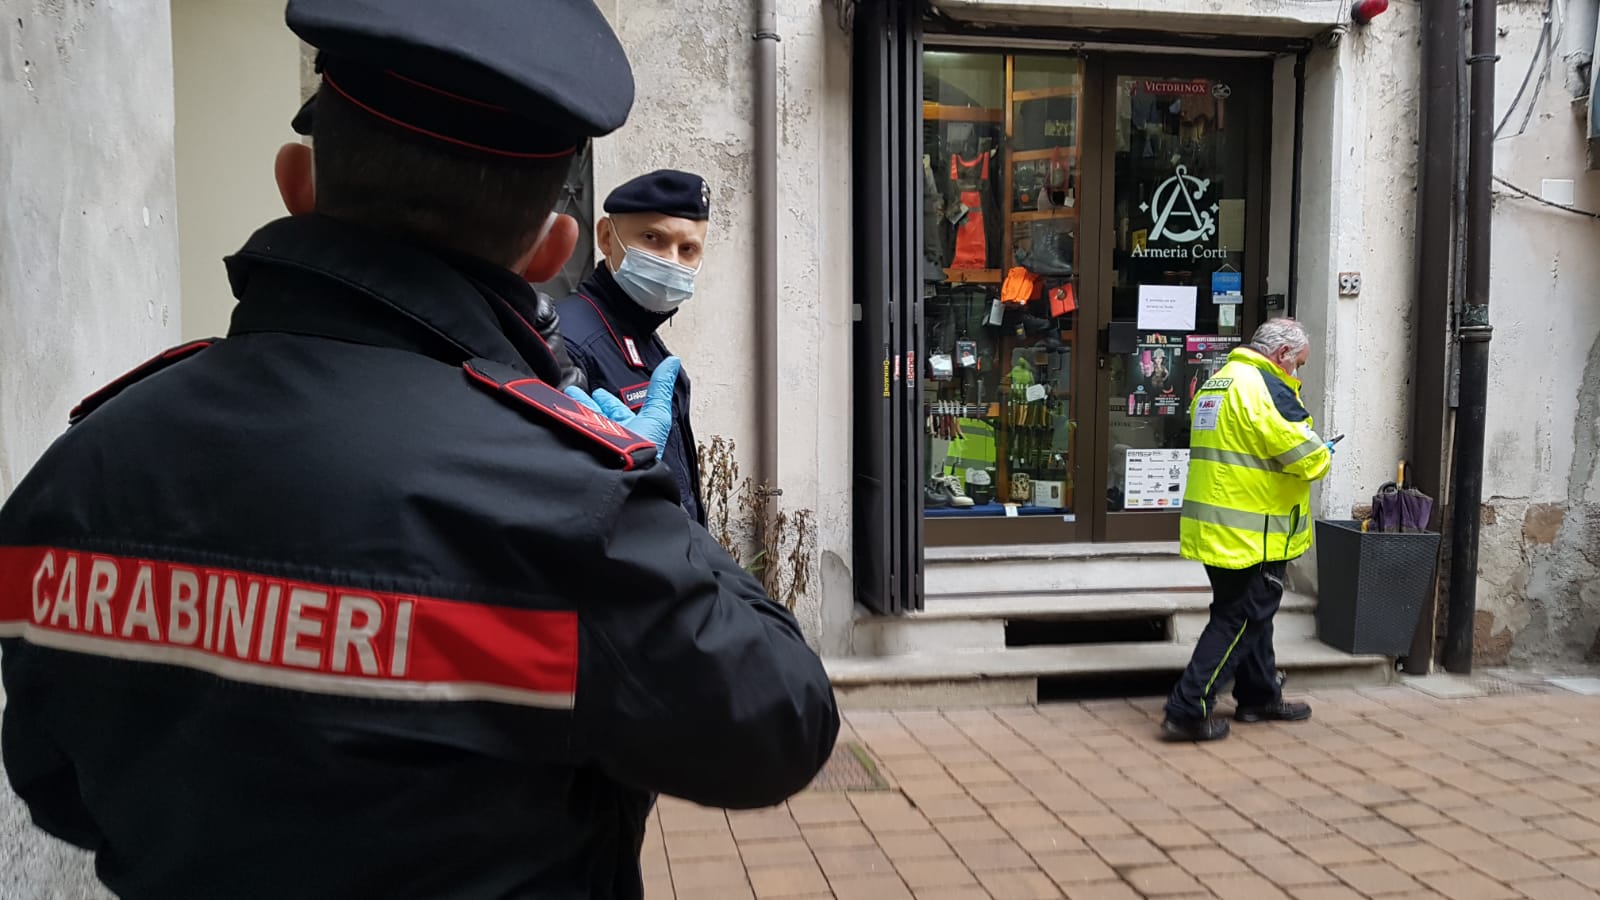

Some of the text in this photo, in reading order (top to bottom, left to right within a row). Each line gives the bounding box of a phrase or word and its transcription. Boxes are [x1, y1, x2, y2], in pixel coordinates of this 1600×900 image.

[1145, 81, 1206, 93] VICTORINOX
[1131, 244, 1228, 259] Armeria Corti
[32, 551, 415, 677] CARABINIERI
